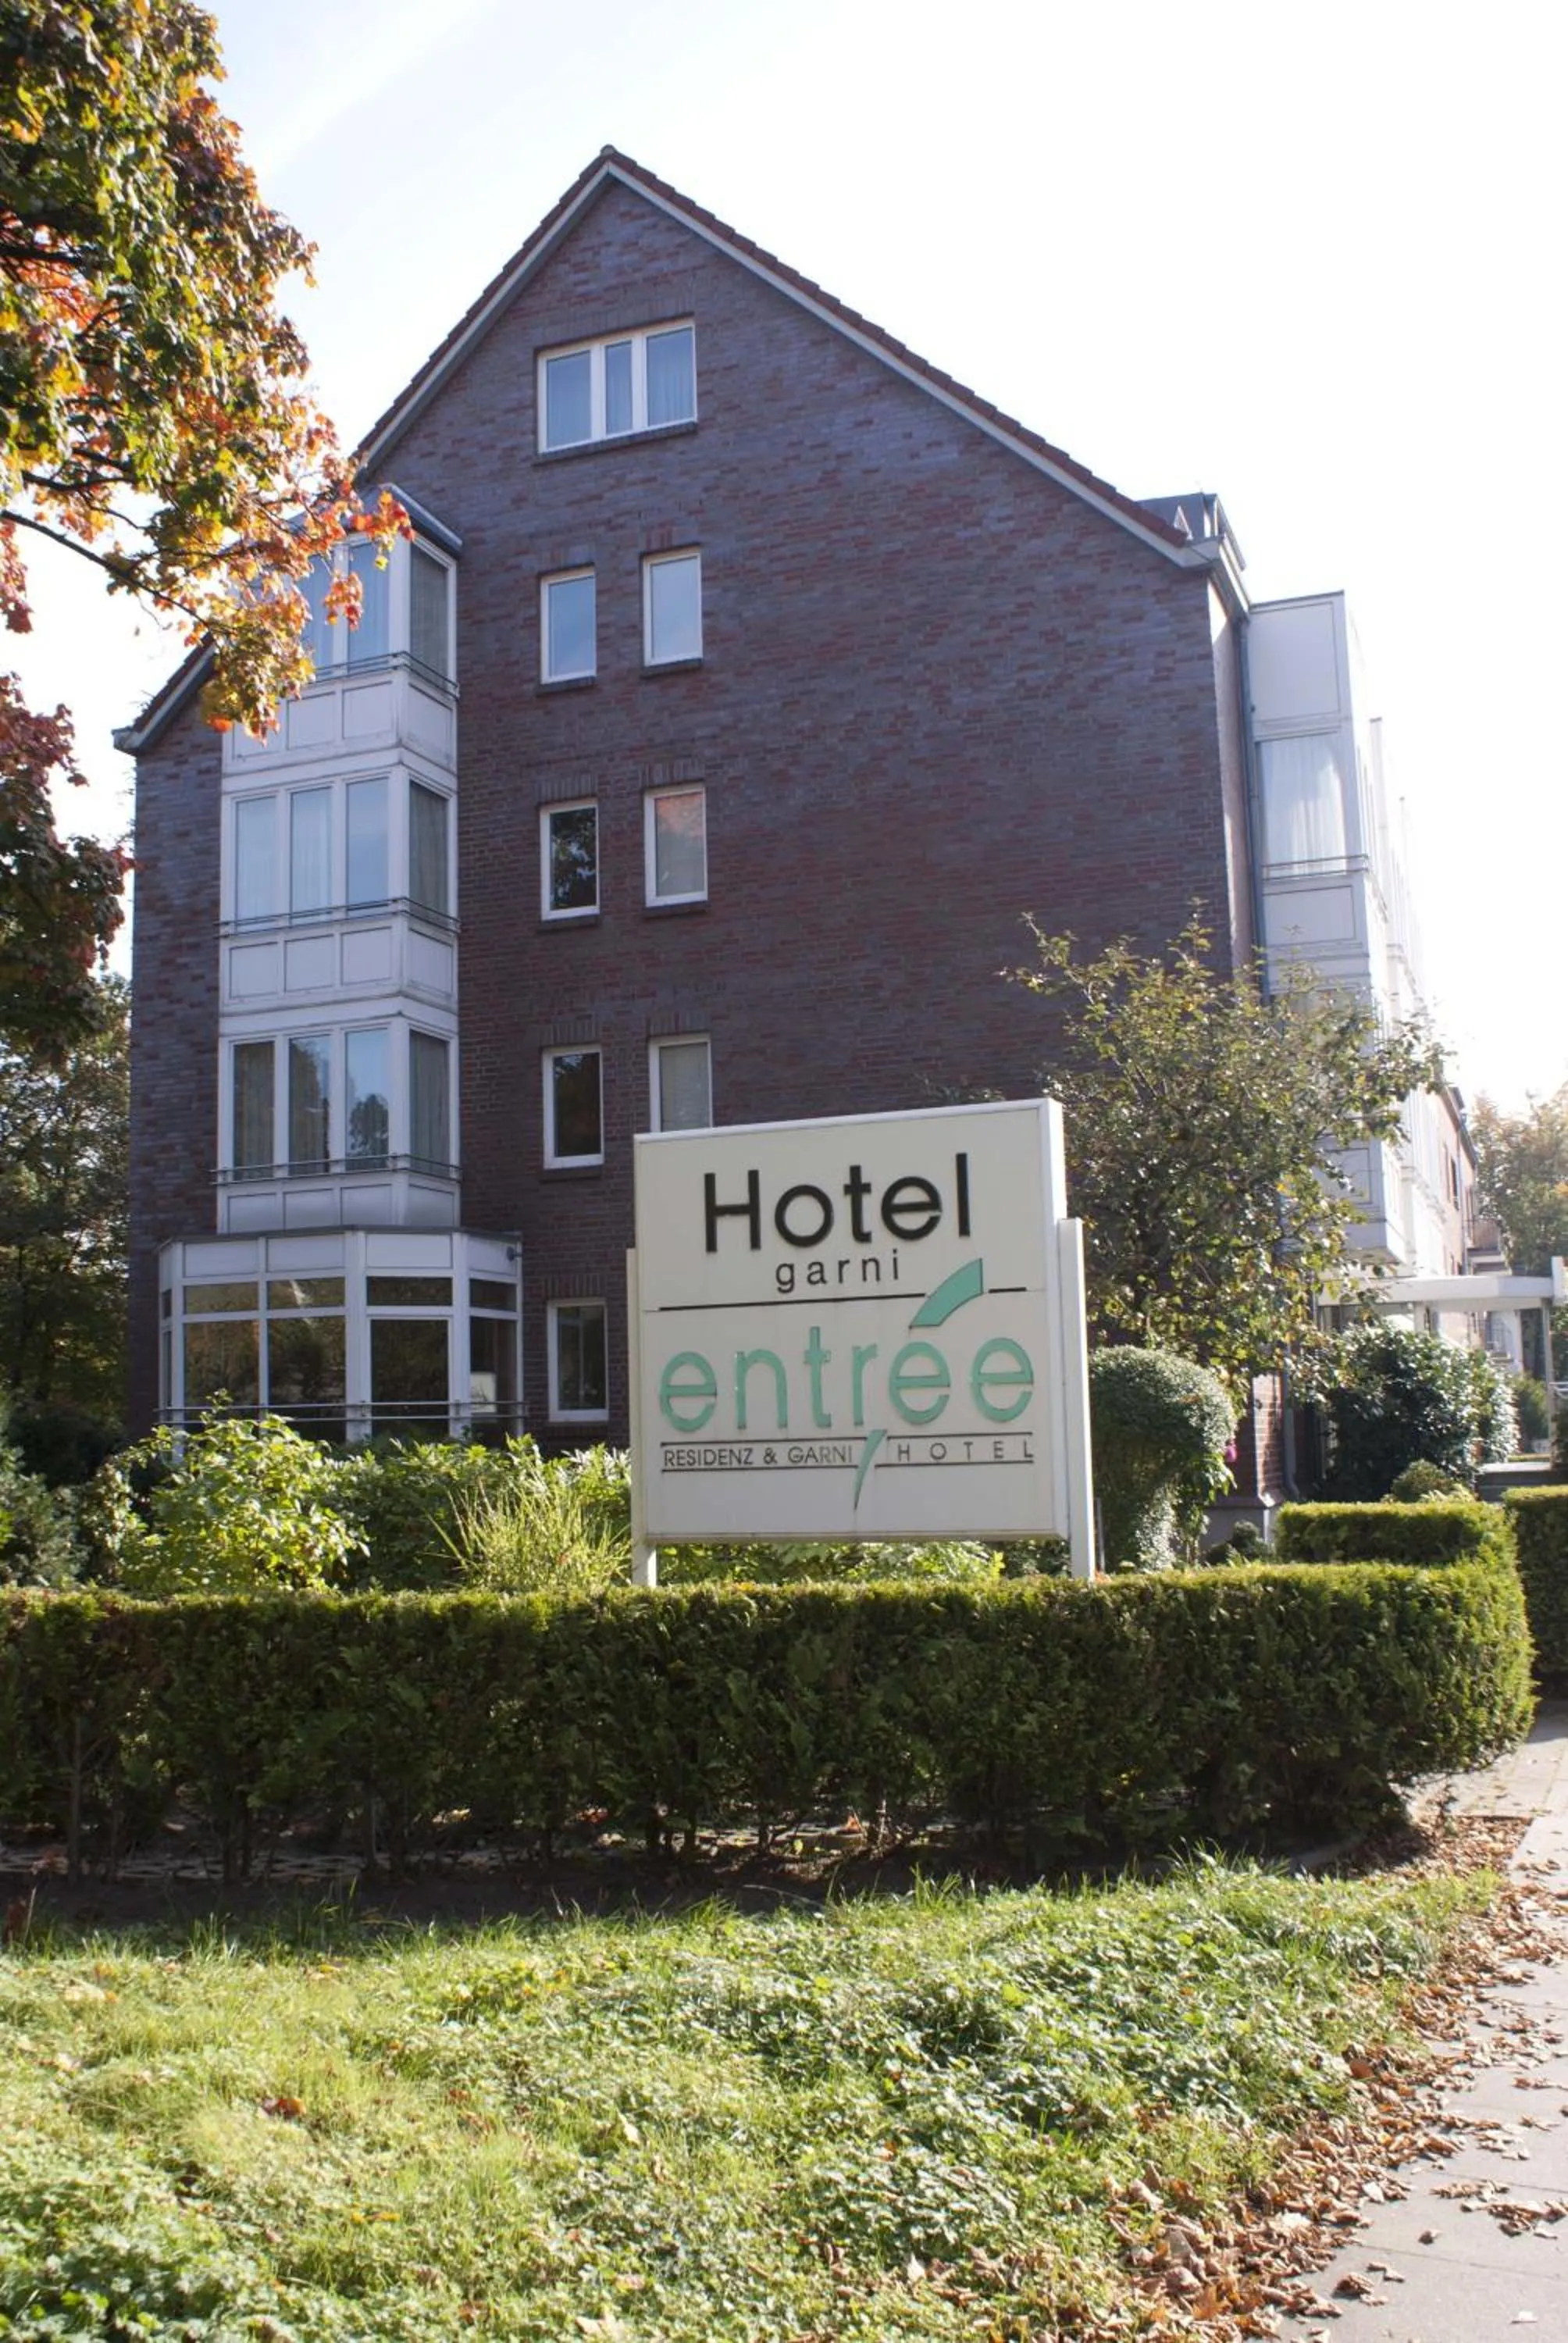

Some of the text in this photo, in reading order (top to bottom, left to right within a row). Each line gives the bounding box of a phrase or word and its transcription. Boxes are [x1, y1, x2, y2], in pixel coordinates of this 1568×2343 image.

[704, 1152, 971, 1253] Hotel
[775, 1249, 900, 1293] garni
[658, 1257, 1035, 1432] entrée
[663, 1440, 1035, 1467] RESIDENZ & GARNI HOTEL
